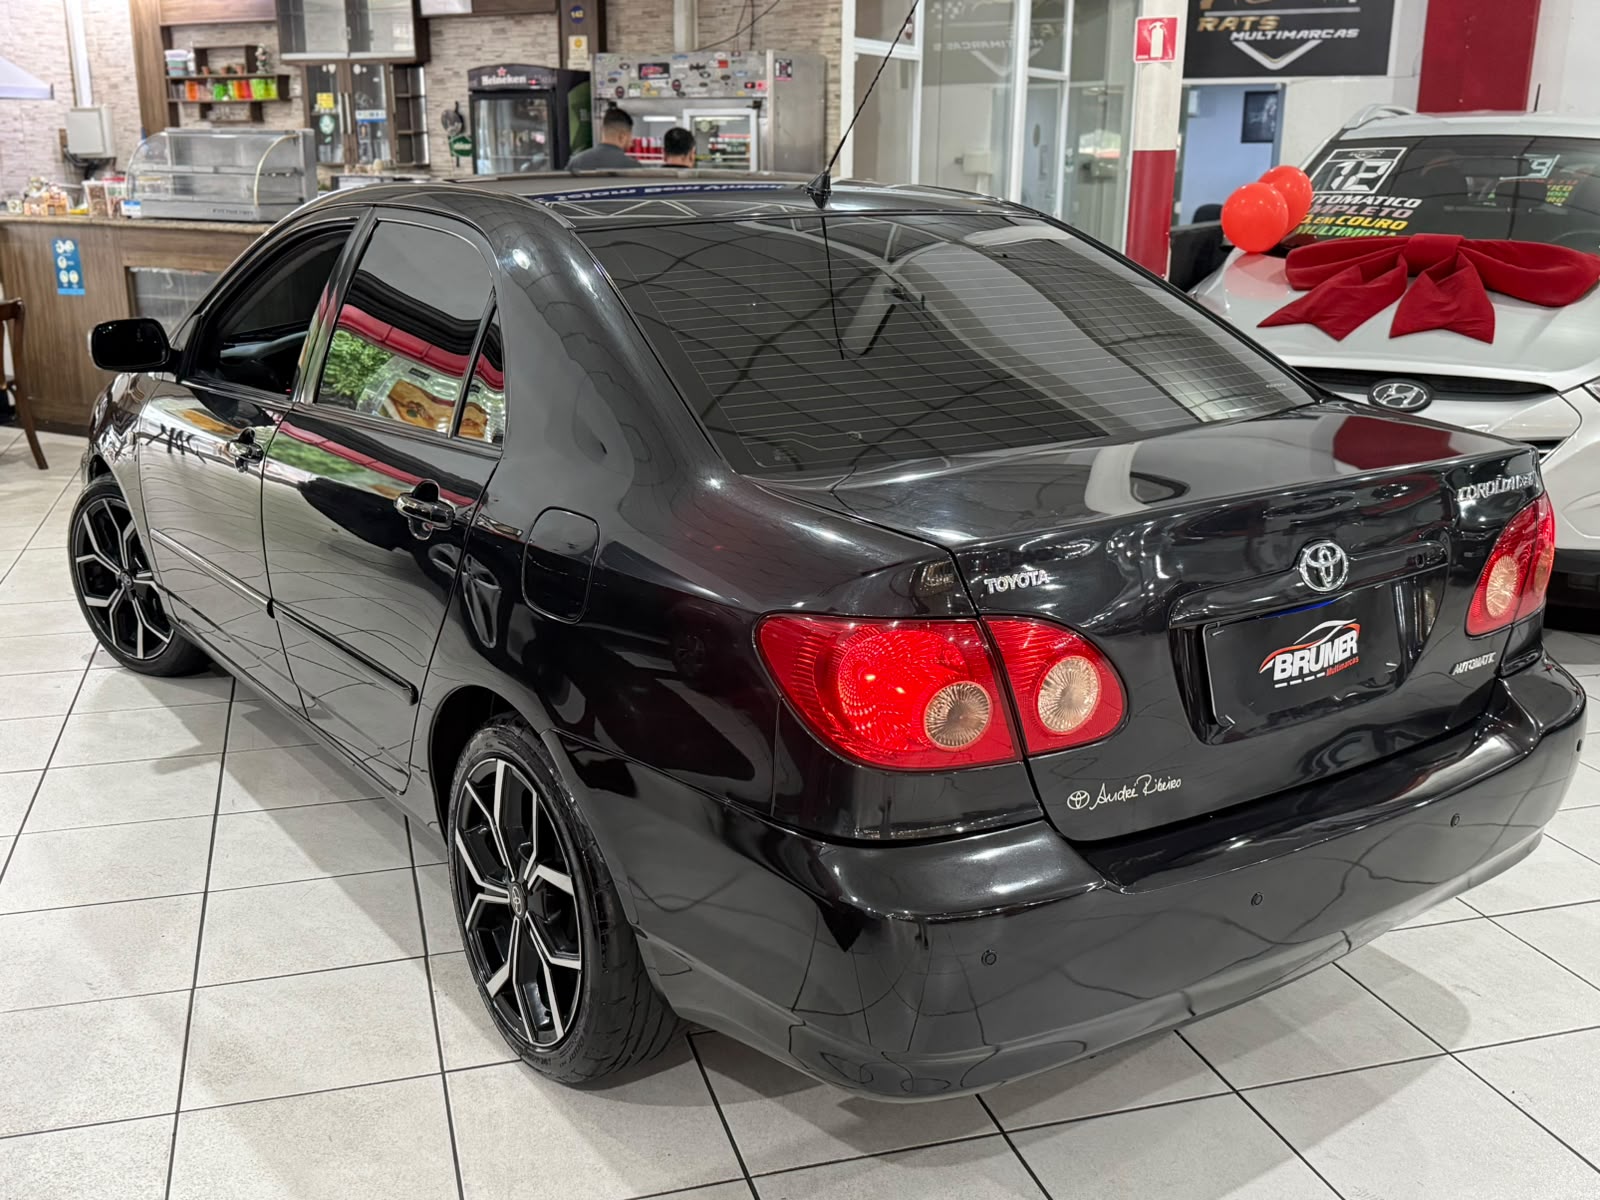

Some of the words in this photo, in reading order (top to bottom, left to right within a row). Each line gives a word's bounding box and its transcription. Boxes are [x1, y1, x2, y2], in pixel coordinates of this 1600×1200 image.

[1197, 16, 1280, 32] RATS
[1230, 29, 1360, 41] MULTIMARCAS
[481, 75, 527, 87] Heineken
[1330, 160, 1392, 191] 12
[1312, 194, 1423, 208] TOMATICO
[1310, 204, 1414, 219] MPLETO
[1335, 215, 1409, 231] COURO
[984, 569, 1050, 594] TOYOTA
[1273, 630, 1358, 681] BRUMER
[1326, 656, 1360, 677] Multimarcas
